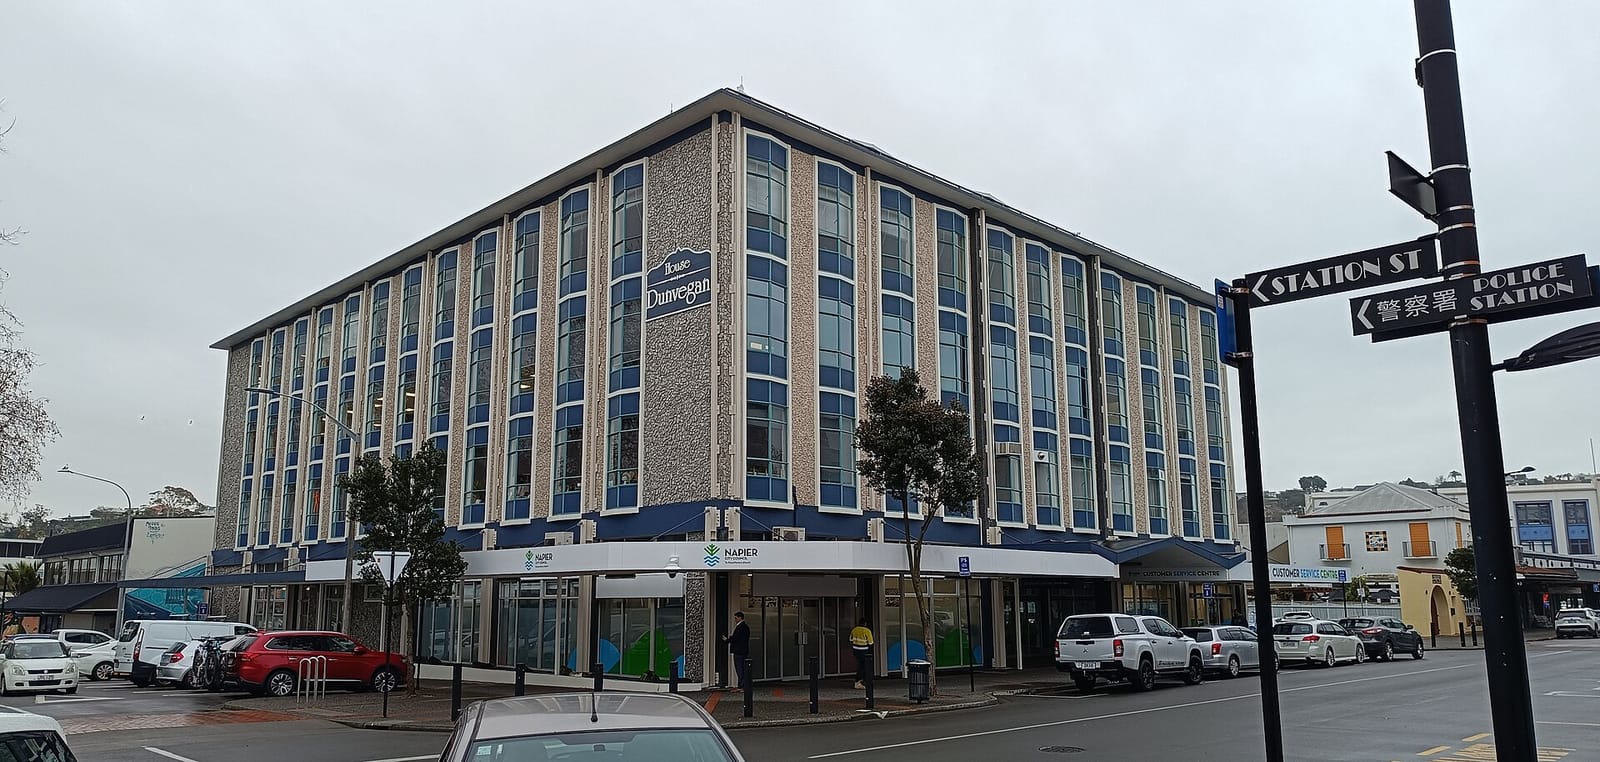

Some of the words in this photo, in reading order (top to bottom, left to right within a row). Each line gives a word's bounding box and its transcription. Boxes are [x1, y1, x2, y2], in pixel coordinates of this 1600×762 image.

[664, 259, 691, 275] House
[1271, 257, 1381, 296] STATION
[1389, 249, 1421, 274] ST
[1473, 263, 1566, 293] POLICE
[647, 278, 711, 309] Dunvegan
[1376, 288, 1458, 323] 警察署
[1470, 280, 1574, 311] STATION
[535, 553, 553, 561] NAPIER
[725, 548, 758, 556] NAPIER
[1272, 568, 1300, 578] CUSTOMER
[1300, 568, 1320, 579] SERVICE
[1320, 569, 1338, 579] CENTRE
